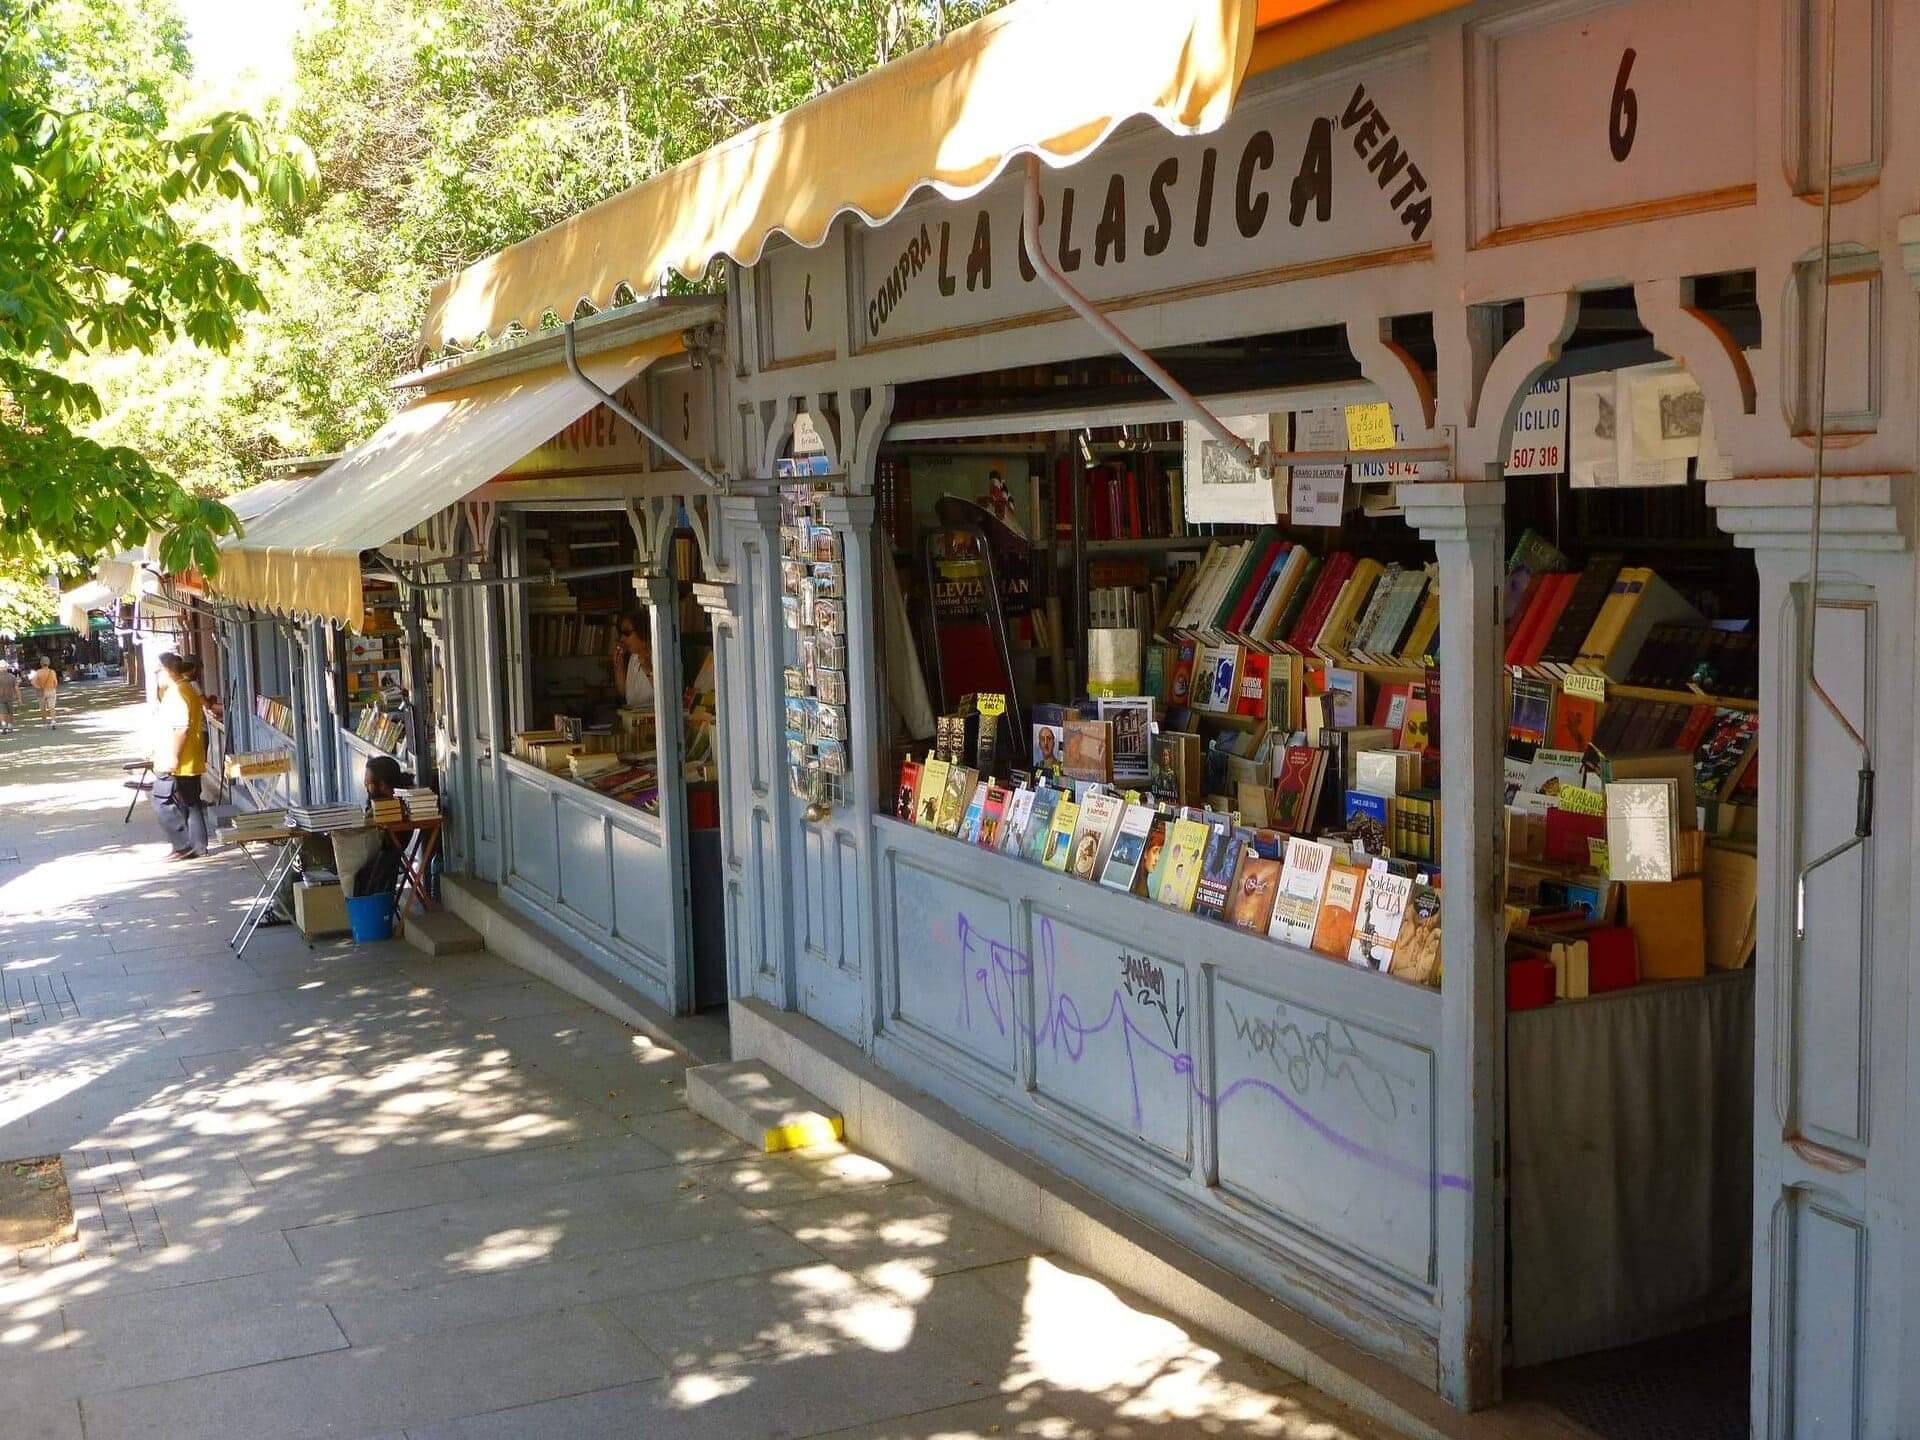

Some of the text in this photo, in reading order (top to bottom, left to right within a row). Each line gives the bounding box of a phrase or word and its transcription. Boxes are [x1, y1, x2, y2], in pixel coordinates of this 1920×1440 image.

[1608, 47, 1638, 163] 6
[1340, 82, 1433, 242] VENTA
[804, 273, 814, 333] 6
[868, 222, 932, 338] COMPRA
[1513, 448, 1535, 469] 507
[1539, 446, 1558, 467] 318
[1292, 842, 1324, 874] MADRID
[1366, 872, 1408, 897] Soldado
